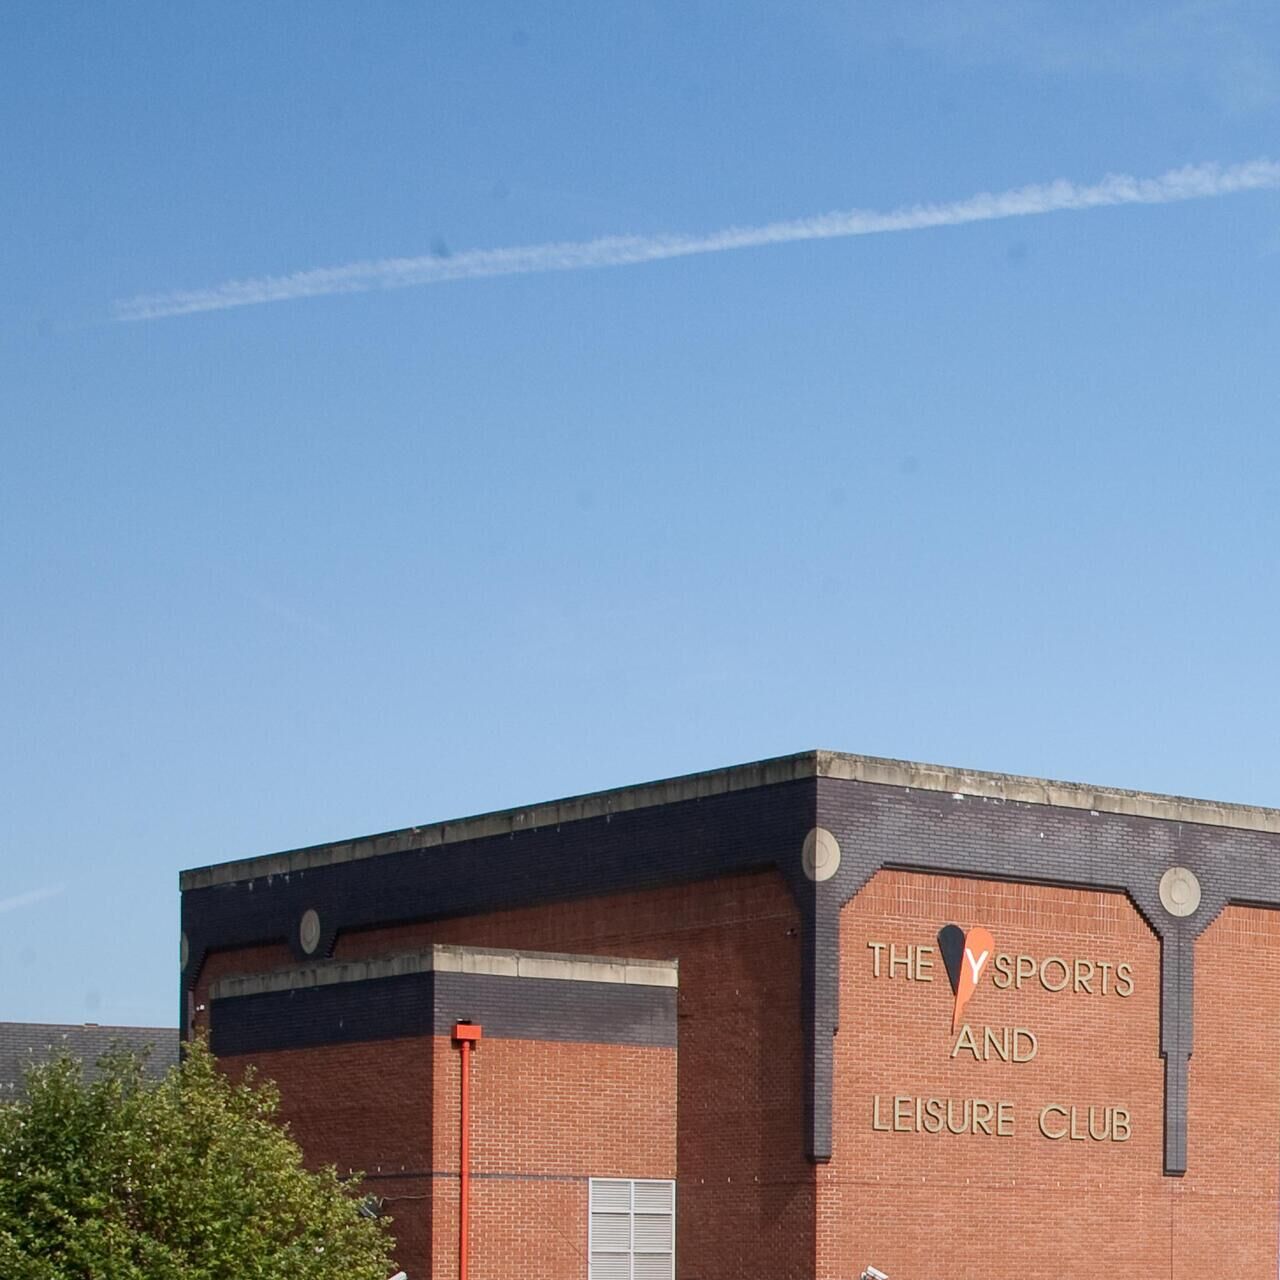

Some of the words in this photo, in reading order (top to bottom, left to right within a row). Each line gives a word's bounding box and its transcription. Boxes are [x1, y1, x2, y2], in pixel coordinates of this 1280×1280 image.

[868, 941, 934, 982] THE
[965, 948, 989, 984] Y
[993, 953, 1135, 997] SPORTS
[951, 1024, 1039, 1063] AND
[873, 1095, 1015, 1137] LEISURE
[1039, 1103, 1132, 1141] CLUB
